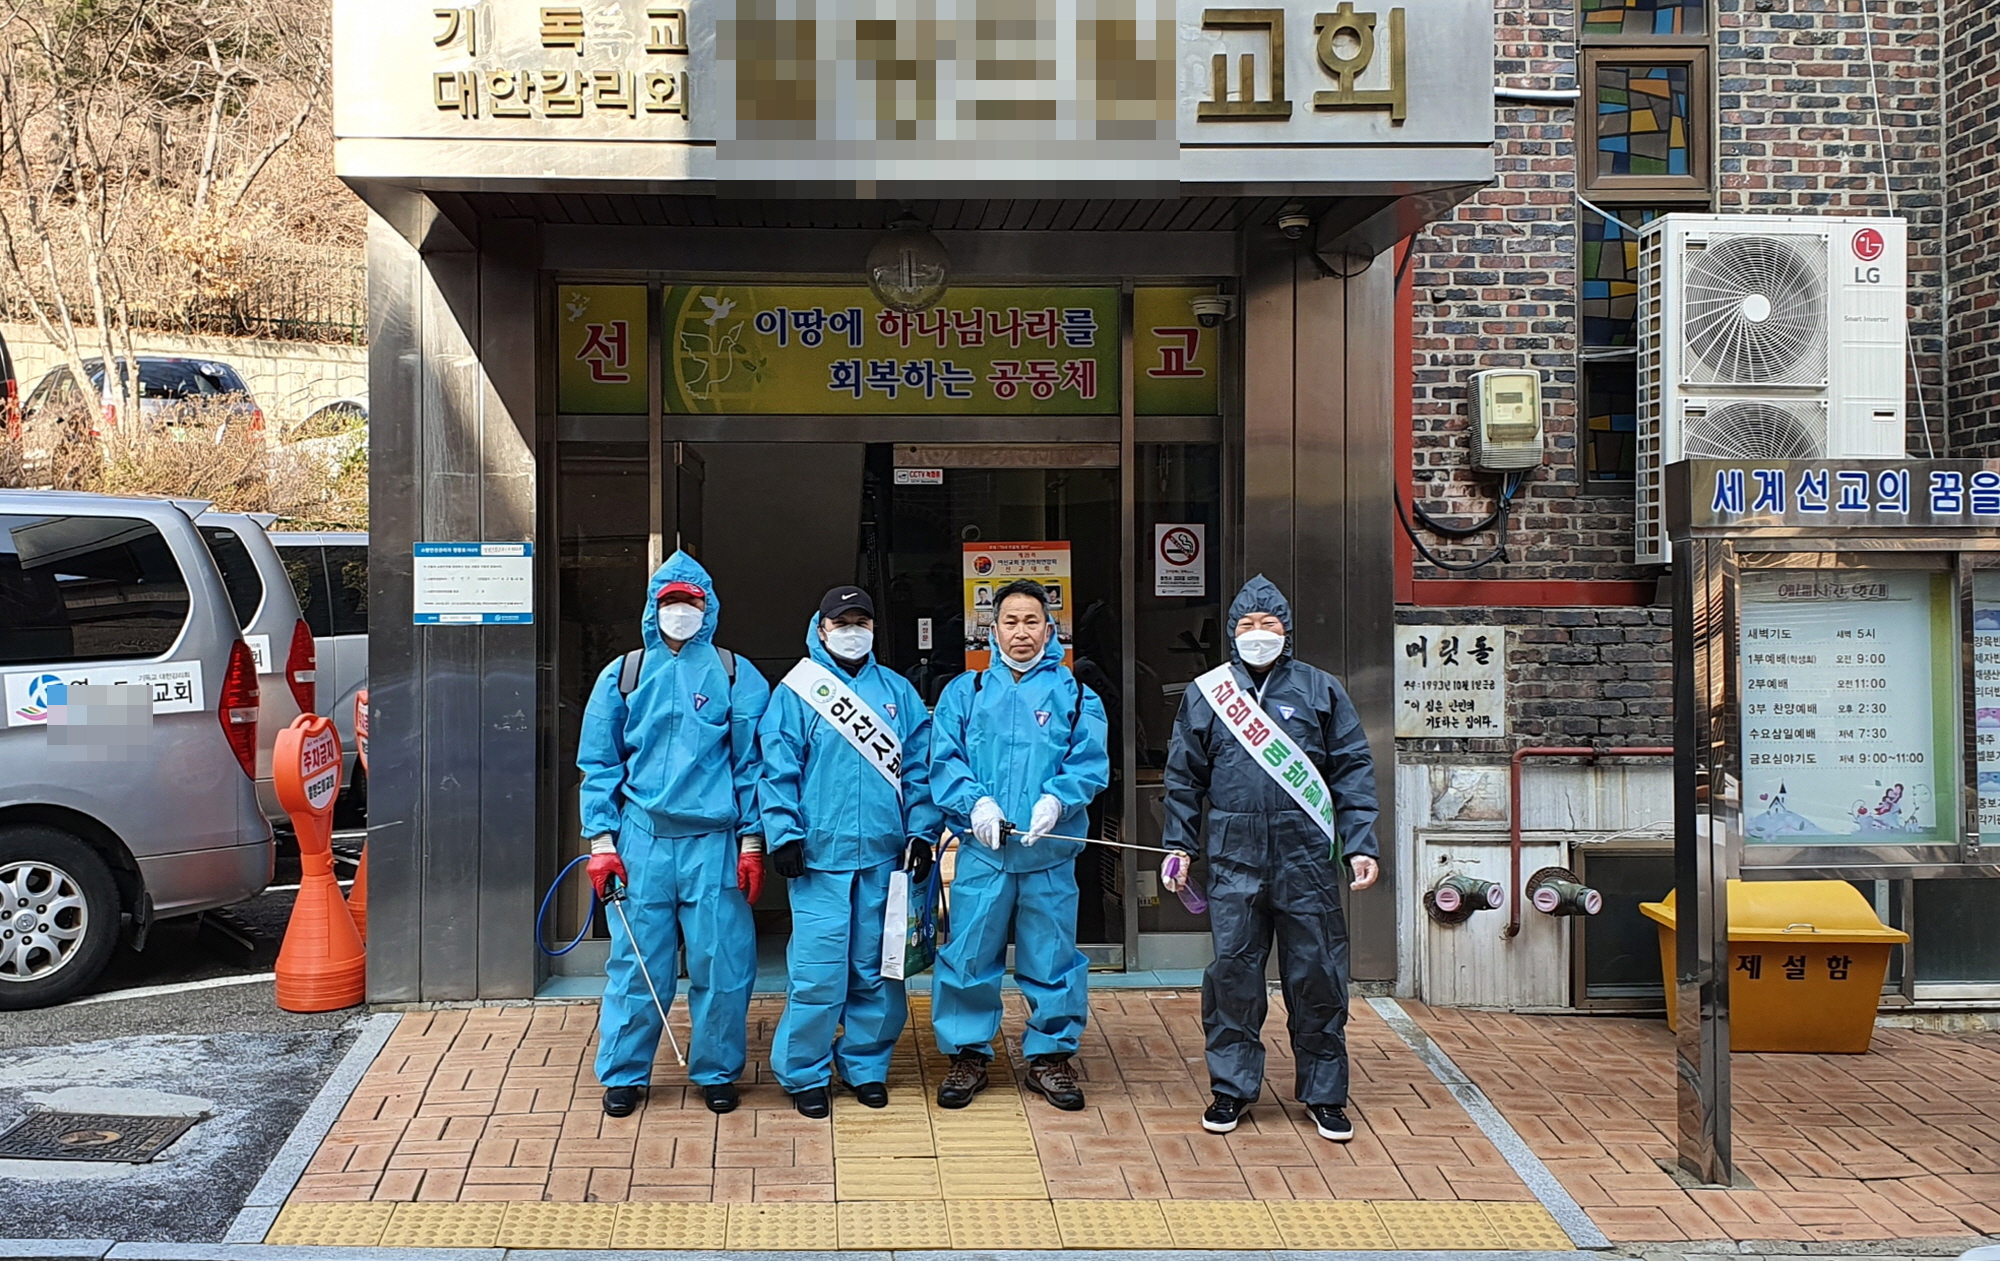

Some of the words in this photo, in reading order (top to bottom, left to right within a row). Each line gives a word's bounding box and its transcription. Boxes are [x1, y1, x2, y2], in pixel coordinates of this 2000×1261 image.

[432, 67, 690, 121] 대한감리회
[1854, 266, 1881, 284] LG
[754, 306, 865, 348] 이땅에
[876, 306, 1098, 348] 하나님나라를
[1843, 315, 1862, 323] Smart
[1863, 315, 1890, 323] Inverter
[576, 319, 633, 385] 선
[1147, 326, 1206, 380] 교
[827, 357, 977, 399] 회복하는
[986, 357, 1098, 400] 공동체
[909, 470, 925, 478] CCTV
[1927, 469, 2000, 516] 꿈을
[1777, 583, 1846, 599] 예배시간
[1747, 628, 1792, 640] 새벽기도
[1836, 629, 1851, 639] 새벽
[1857, 628, 1876, 640] 5시
[1405, 635, 1494, 668] 머릿돌
[1836, 655, 1852, 664] 오전
[1857, 653, 1886, 664] 9:00
[1748, 678, 1789, 690] 2부예배
[1837, 679, 1853, 689] 오전
[1855, 678, 1886, 689] 11:00
[1211, 680, 1271, 748] 감염병
[1748, 703, 1767, 715] 3부
[1773, 703, 1818, 715] 찬양예배
[1837, 704, 1854, 714] 오후
[1858, 703, 1887, 714] 2:30
[1426, 715, 1460, 729] 기도하는
[1749, 728, 1816, 740] 수요삼일예배
[1838, 729, 1854, 739] 저녁
[1858, 728, 1887, 739] 7:30
[302, 738, 335, 773] 주차금지
[1749, 753, 1817, 765] 금요심야기도
[1838, 754, 1854, 764] 저녁
[1859, 752, 1924, 764] 9:00~11:00
